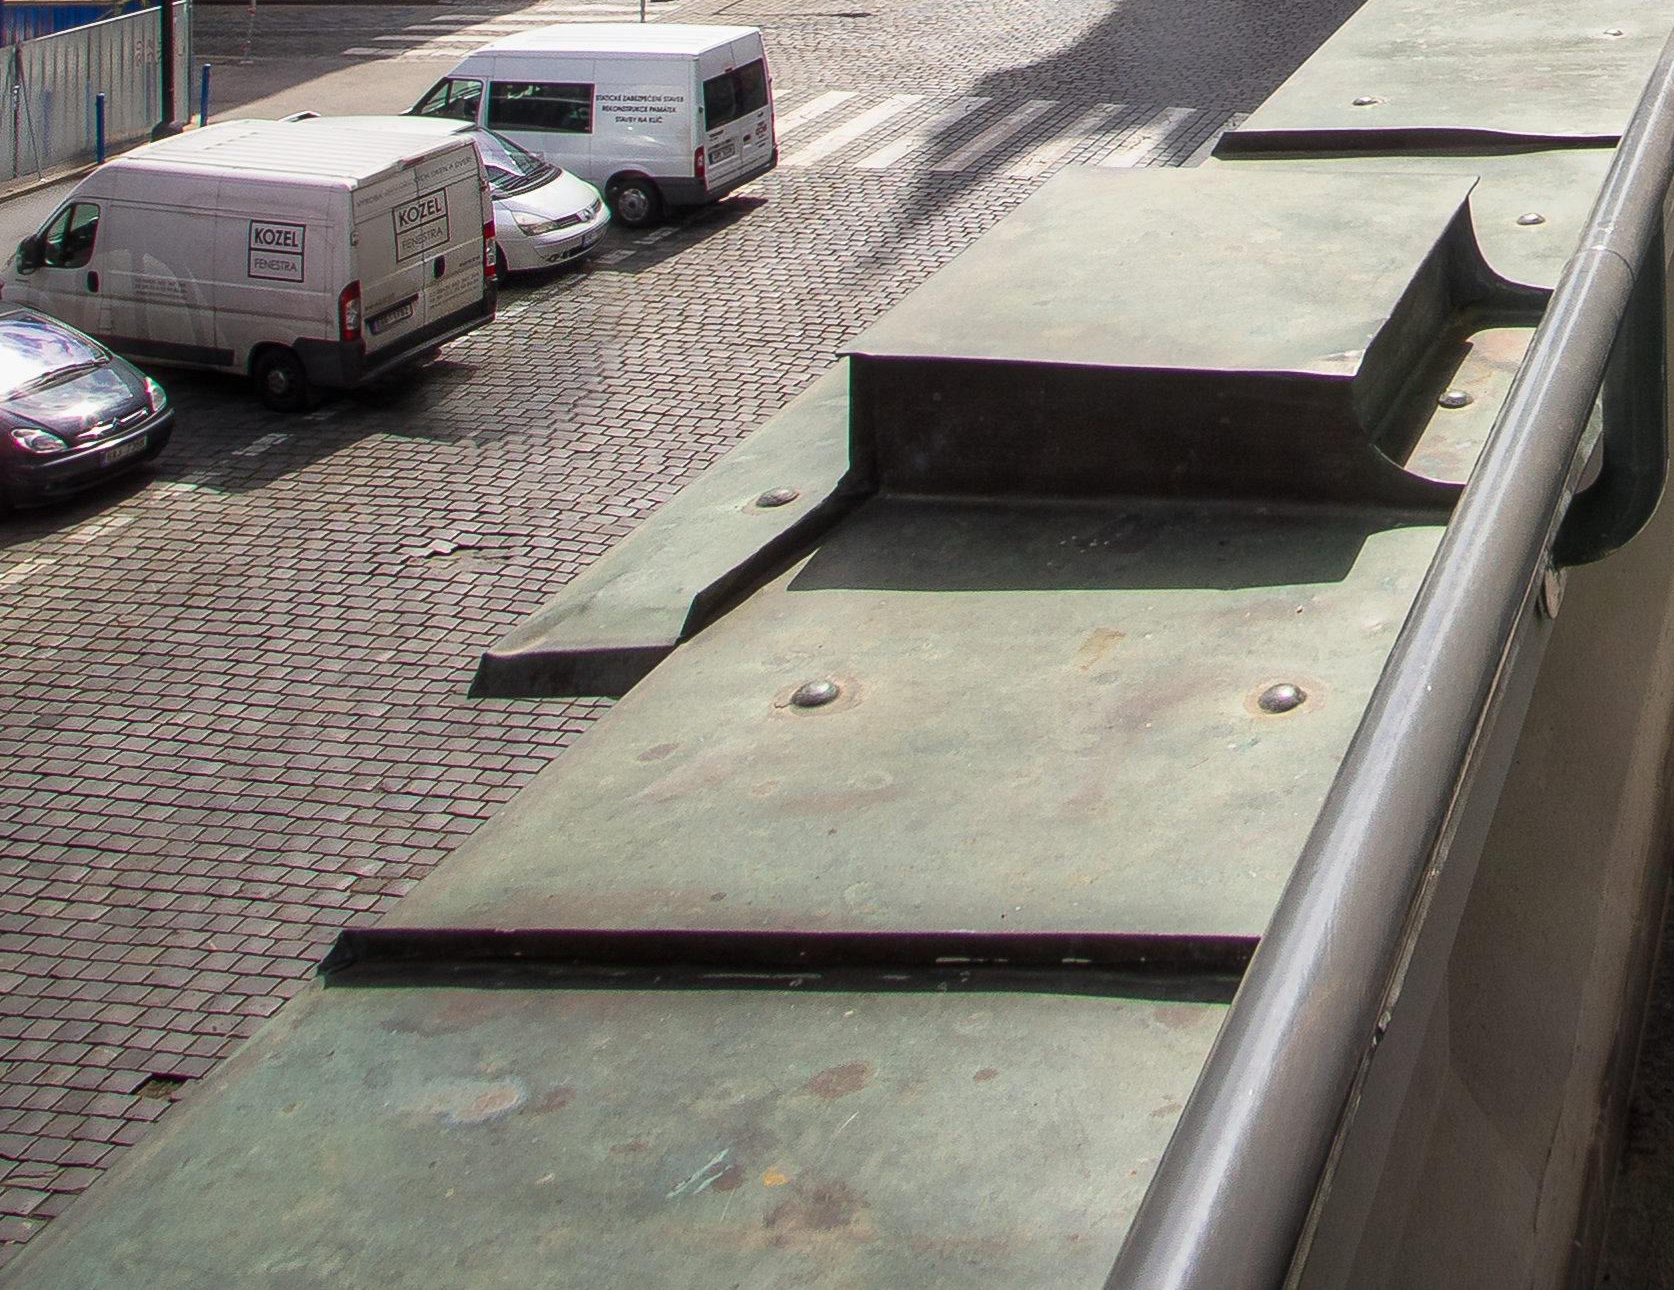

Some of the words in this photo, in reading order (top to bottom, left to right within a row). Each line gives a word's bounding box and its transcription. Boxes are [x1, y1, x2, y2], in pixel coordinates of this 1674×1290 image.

[399, 197, 442, 228] KOZEL
[254, 227, 298, 247] KOZEL
[402, 227, 444, 251] FENESTRA
[254, 258, 297, 272] FENESTRA
